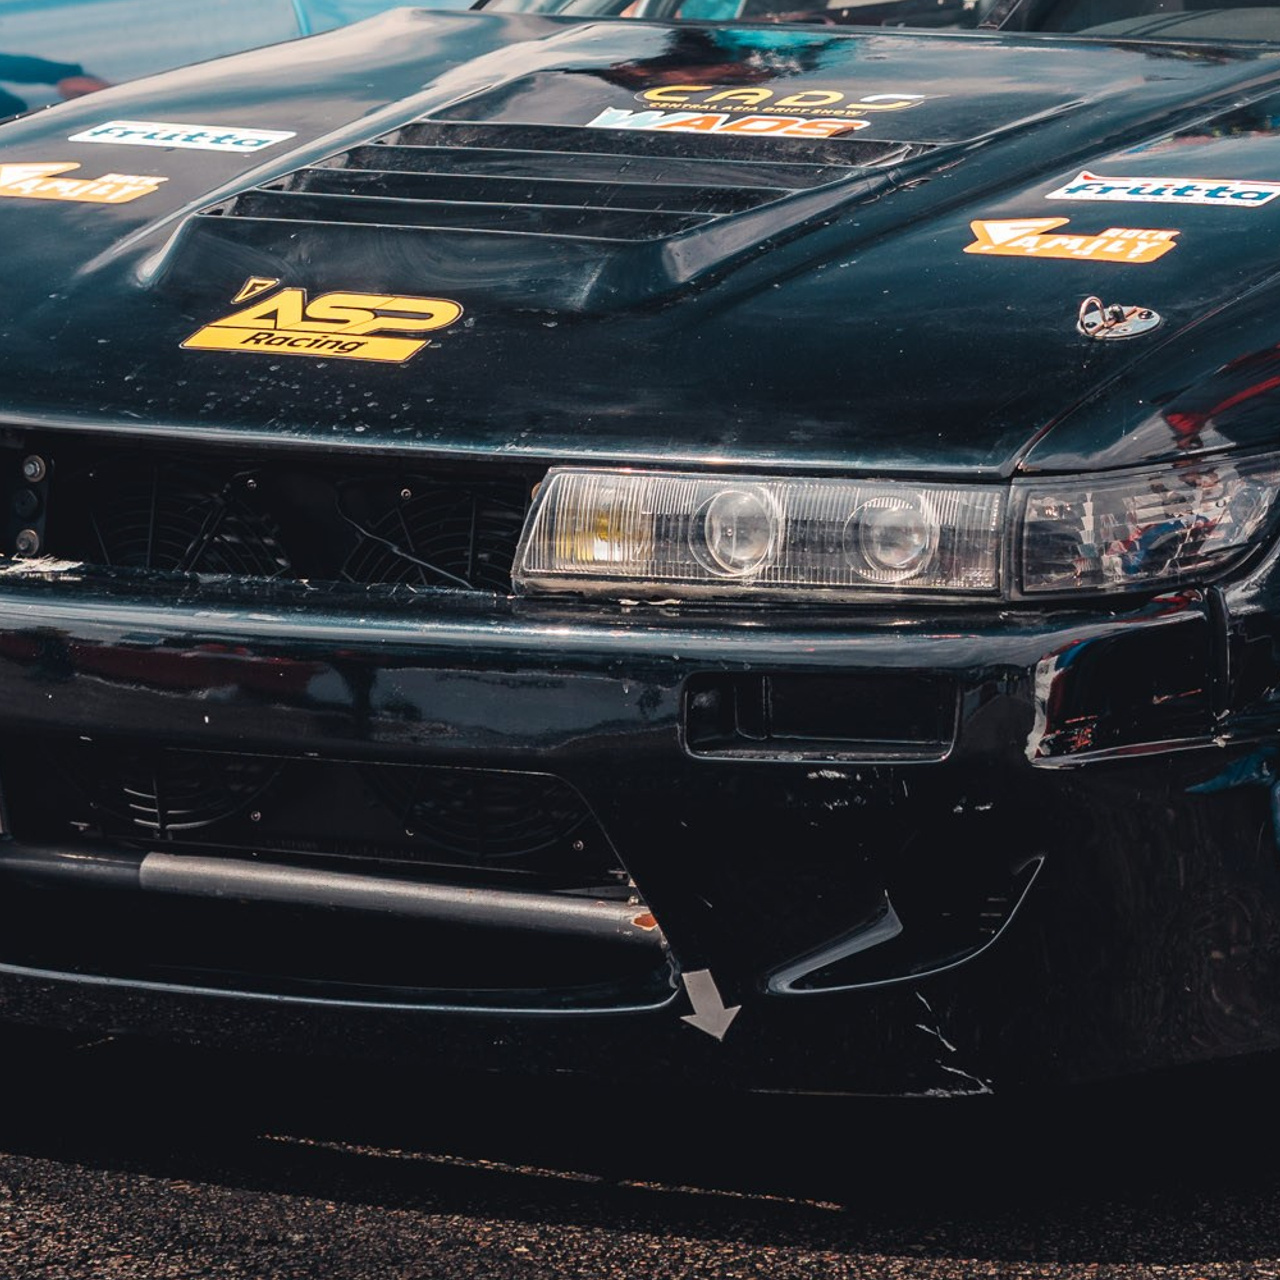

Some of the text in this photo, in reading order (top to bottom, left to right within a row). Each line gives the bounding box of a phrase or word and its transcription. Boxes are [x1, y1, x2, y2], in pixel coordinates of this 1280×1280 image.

[649, 102, 719, 111] CENTRAL
[208, 289, 463, 336] ASP
[239, 331, 369, 354] Racing
